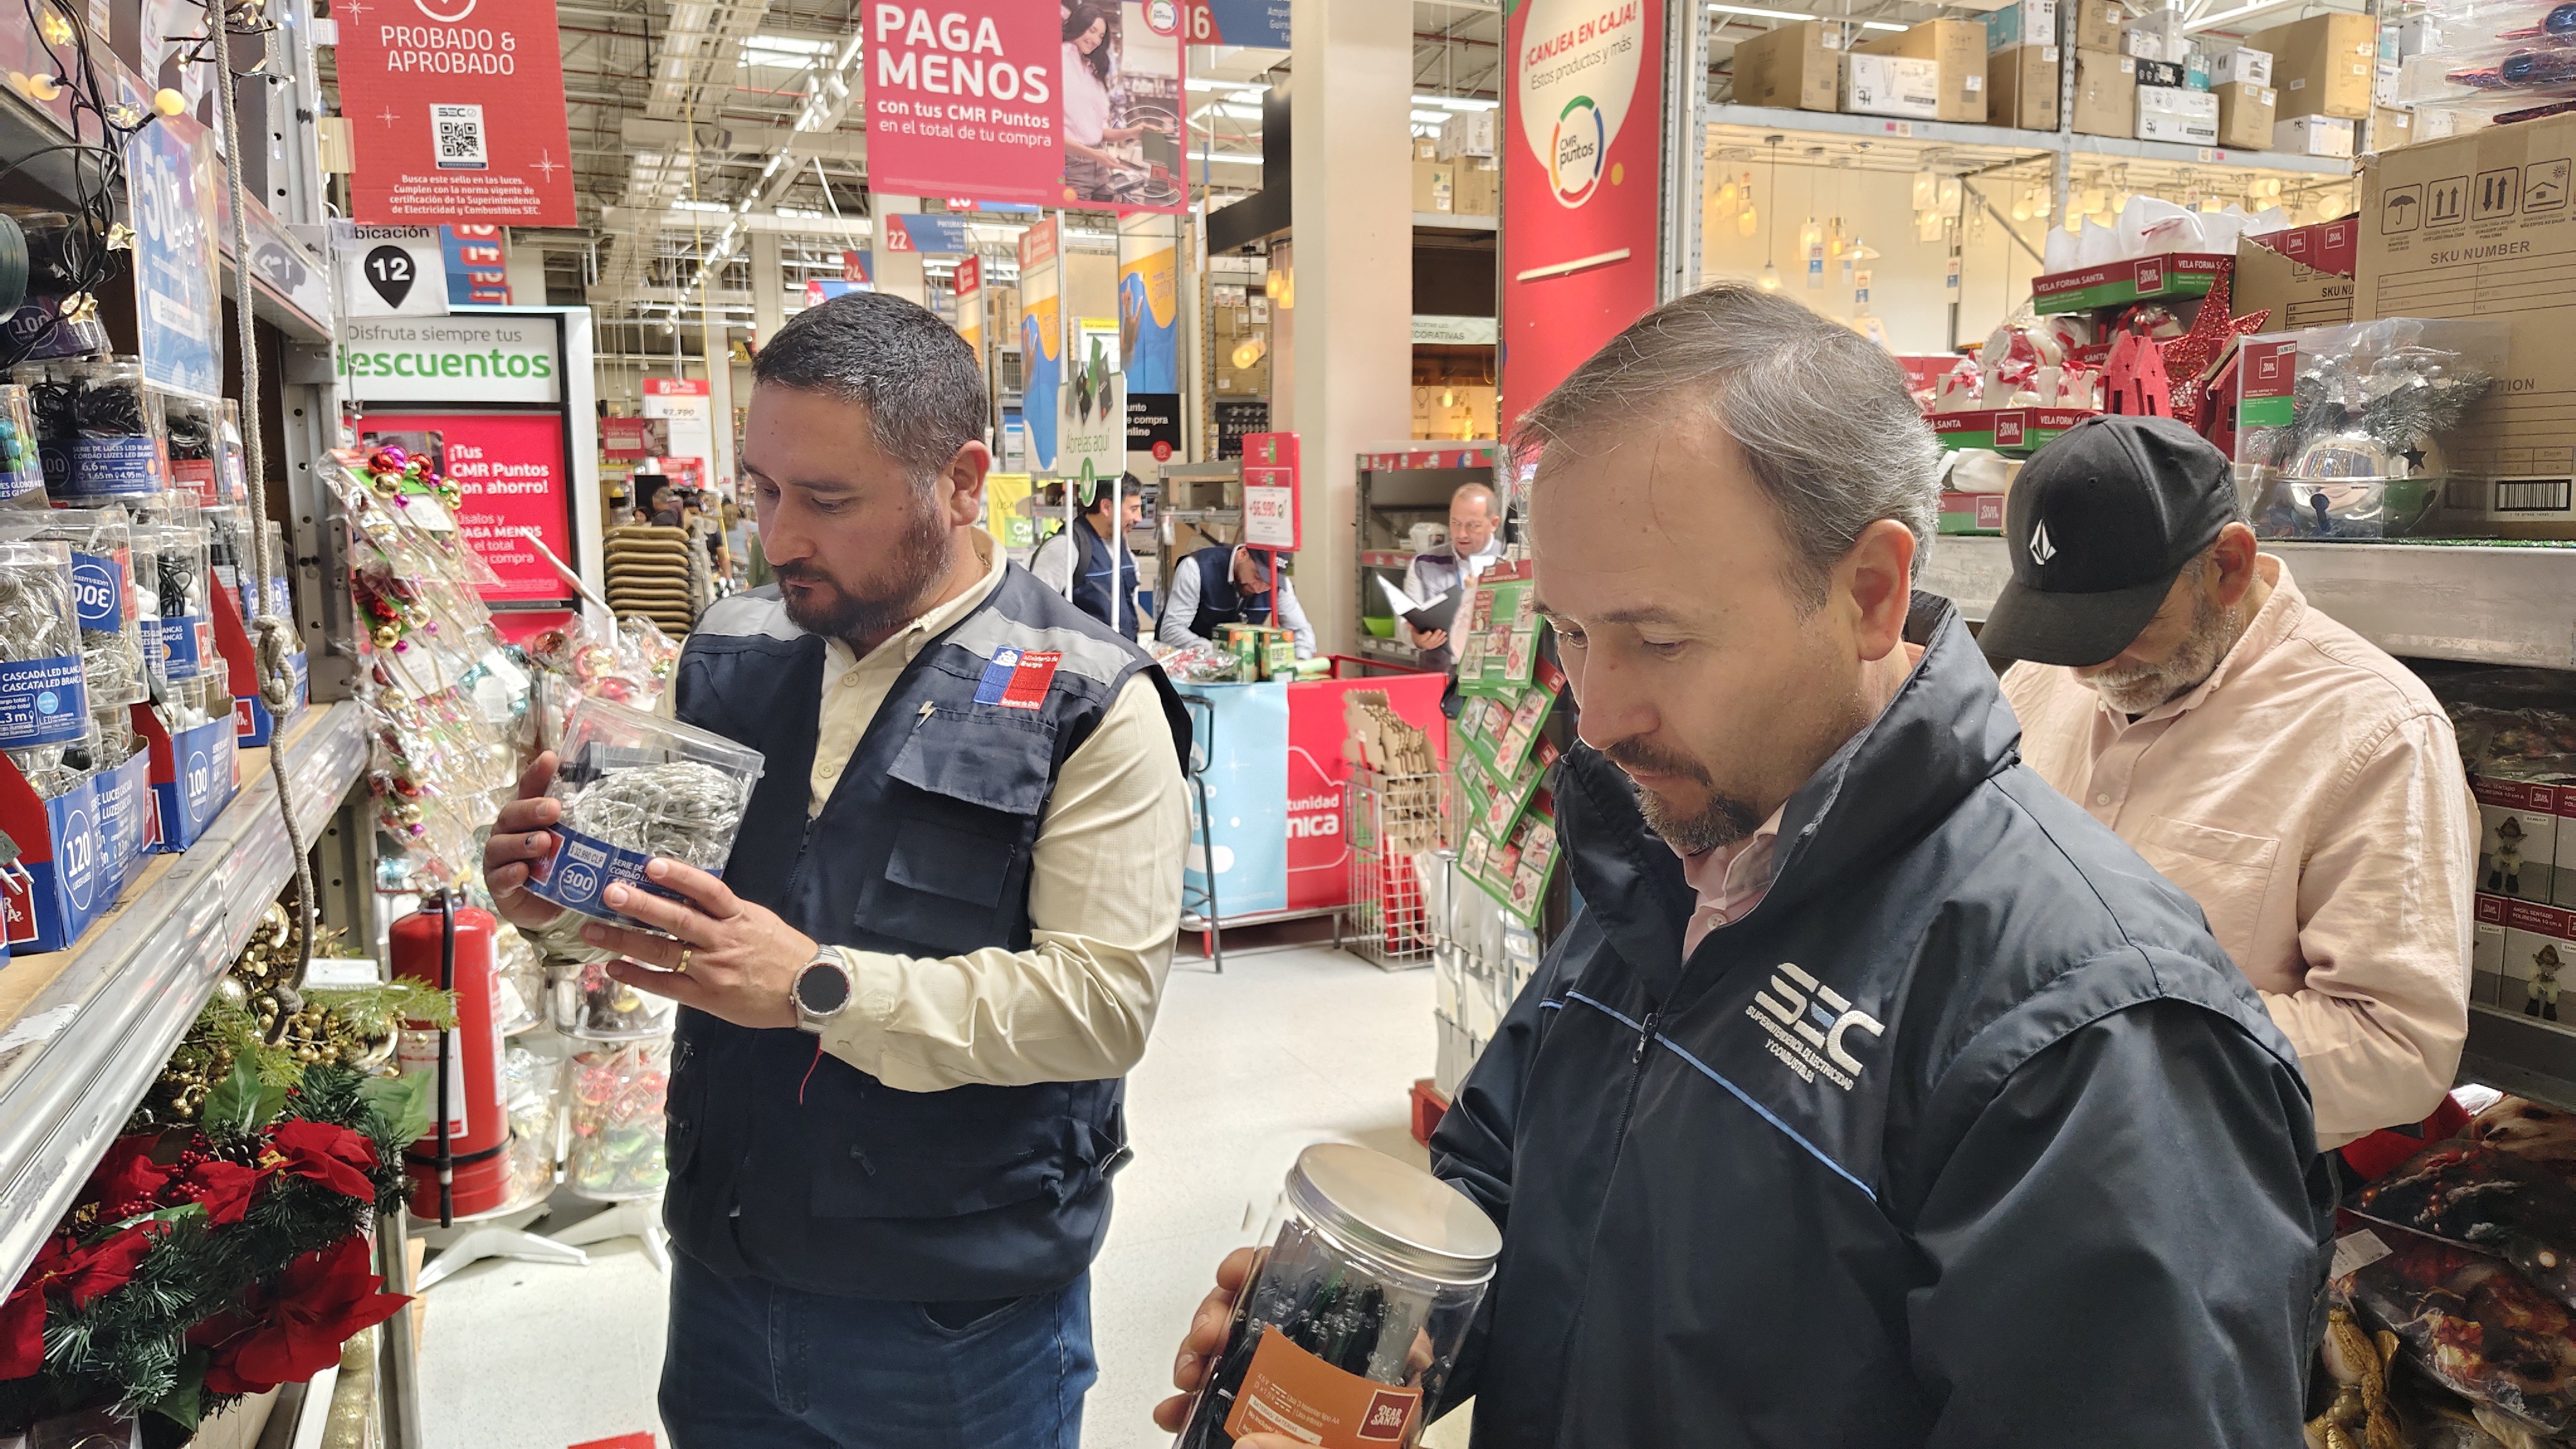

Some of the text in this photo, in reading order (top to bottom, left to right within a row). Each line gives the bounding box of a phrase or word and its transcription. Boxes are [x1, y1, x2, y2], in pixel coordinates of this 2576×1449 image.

[876, 4, 1004, 57] PAGA
[1524, 2, 1638, 72] ¡CANJEA EN CAJA!
[381, 25, 516, 52] PROBADO &
[387, 50, 515, 75] APROBADO
[1531, 35, 1631, 91] Estos productos y más
[878, 50, 1050, 104] MENOS
[878, 101, 1050, 129] con tus CMR Puntos
[880, 120, 1052, 148] en el total de tu compra
[1560, 135, 1577, 151] CMR
[1560, 142, 1594, 170] puntos
[402, 174, 428, 185] Busca
[430, 176, 448, 184] este
[450, 176, 470, 184] sello
[501, 177, 525, 186] luces.
[394, 184, 432, 196] Cumplen
[451, 186, 459, 194] la
[462, 187, 489, 195] norma
[491, 187, 522, 197] vigente
[524, 187, 535, 195] de
[389, 195, 541, 206] certificación de la Superintendencia
[392, 206, 402, 214] de
[404, 206, 455, 215] Electricidad
[465, 206, 522, 215] Combustibles
[888, 231, 908, 250] 22
[2430, 241, 2531, 265] SKU NUMBER
[372, 258, 411, 282] 12
[2178, 259, 2215, 269] VELA FORMA
[846, 265, 862, 281] 24
[2140, 269, 2157, 277] DEAR
[2140, 275, 2159, 284] SANTA
[2037, 272, 2105, 292] VELA FORMA SANTA
[2321, 284, 2354, 297] SKU NU
[809, 292, 825, 307] 26
[349, 326, 522, 345] Disfruta siempre tus
[338, 344, 551, 377] escuentos
[2084, 353, 2107, 363] SANTA
[1134, 416, 1169, 426] compra
[1937, 419, 1962, 428] SANTA
[2040, 415, 2055, 425] VELA
[1999, 428, 2020, 437] SANTA
[1066, 428, 1109, 457] Ábrelas aquí
[74, 452, 102, 460] CORDÃO
[450, 445, 483, 459] ¡Tus
[82, 462, 98, 471] 6.6
[451, 462, 550, 478] CMR Puntos
[462, 479, 548, 494] on ahorro!
[457, 513, 505, 526] Úsalos y
[460, 526, 542, 538] PAGA MENOS
[474, 539, 514, 552] el total
[489, 553, 535, 565] compra
[2, 665, 82, 682] CASCADA LED BLANCA
[2, 675, 82, 692] CASCATA LED BRANCA
[14, 714, 27, 723] m
[39, 715, 53, 725] LED
[188, 767, 208, 798] 100
[103, 787, 120, 804] LUCES
[103, 803, 120, 819] LUZES
[66, 831, 91, 878] 120
[570, 845, 604, 865] $ 32.990 CLP
[609, 865, 641, 880] CORDÃO
[613, 858, 644, 873] SERIE DE
[563, 869, 593, 890] 300
[2512, 913, 2541, 923] POLIRESINA
[2530, 910, 2553, 919] SENTADO
[1755, 962, 1885, 1077] SEC
[1764, 1038, 1772, 1048] Y
[1378, 1404, 1402, 1417] DEAR
[1370, 1414, 1402, 1428] SANTA
